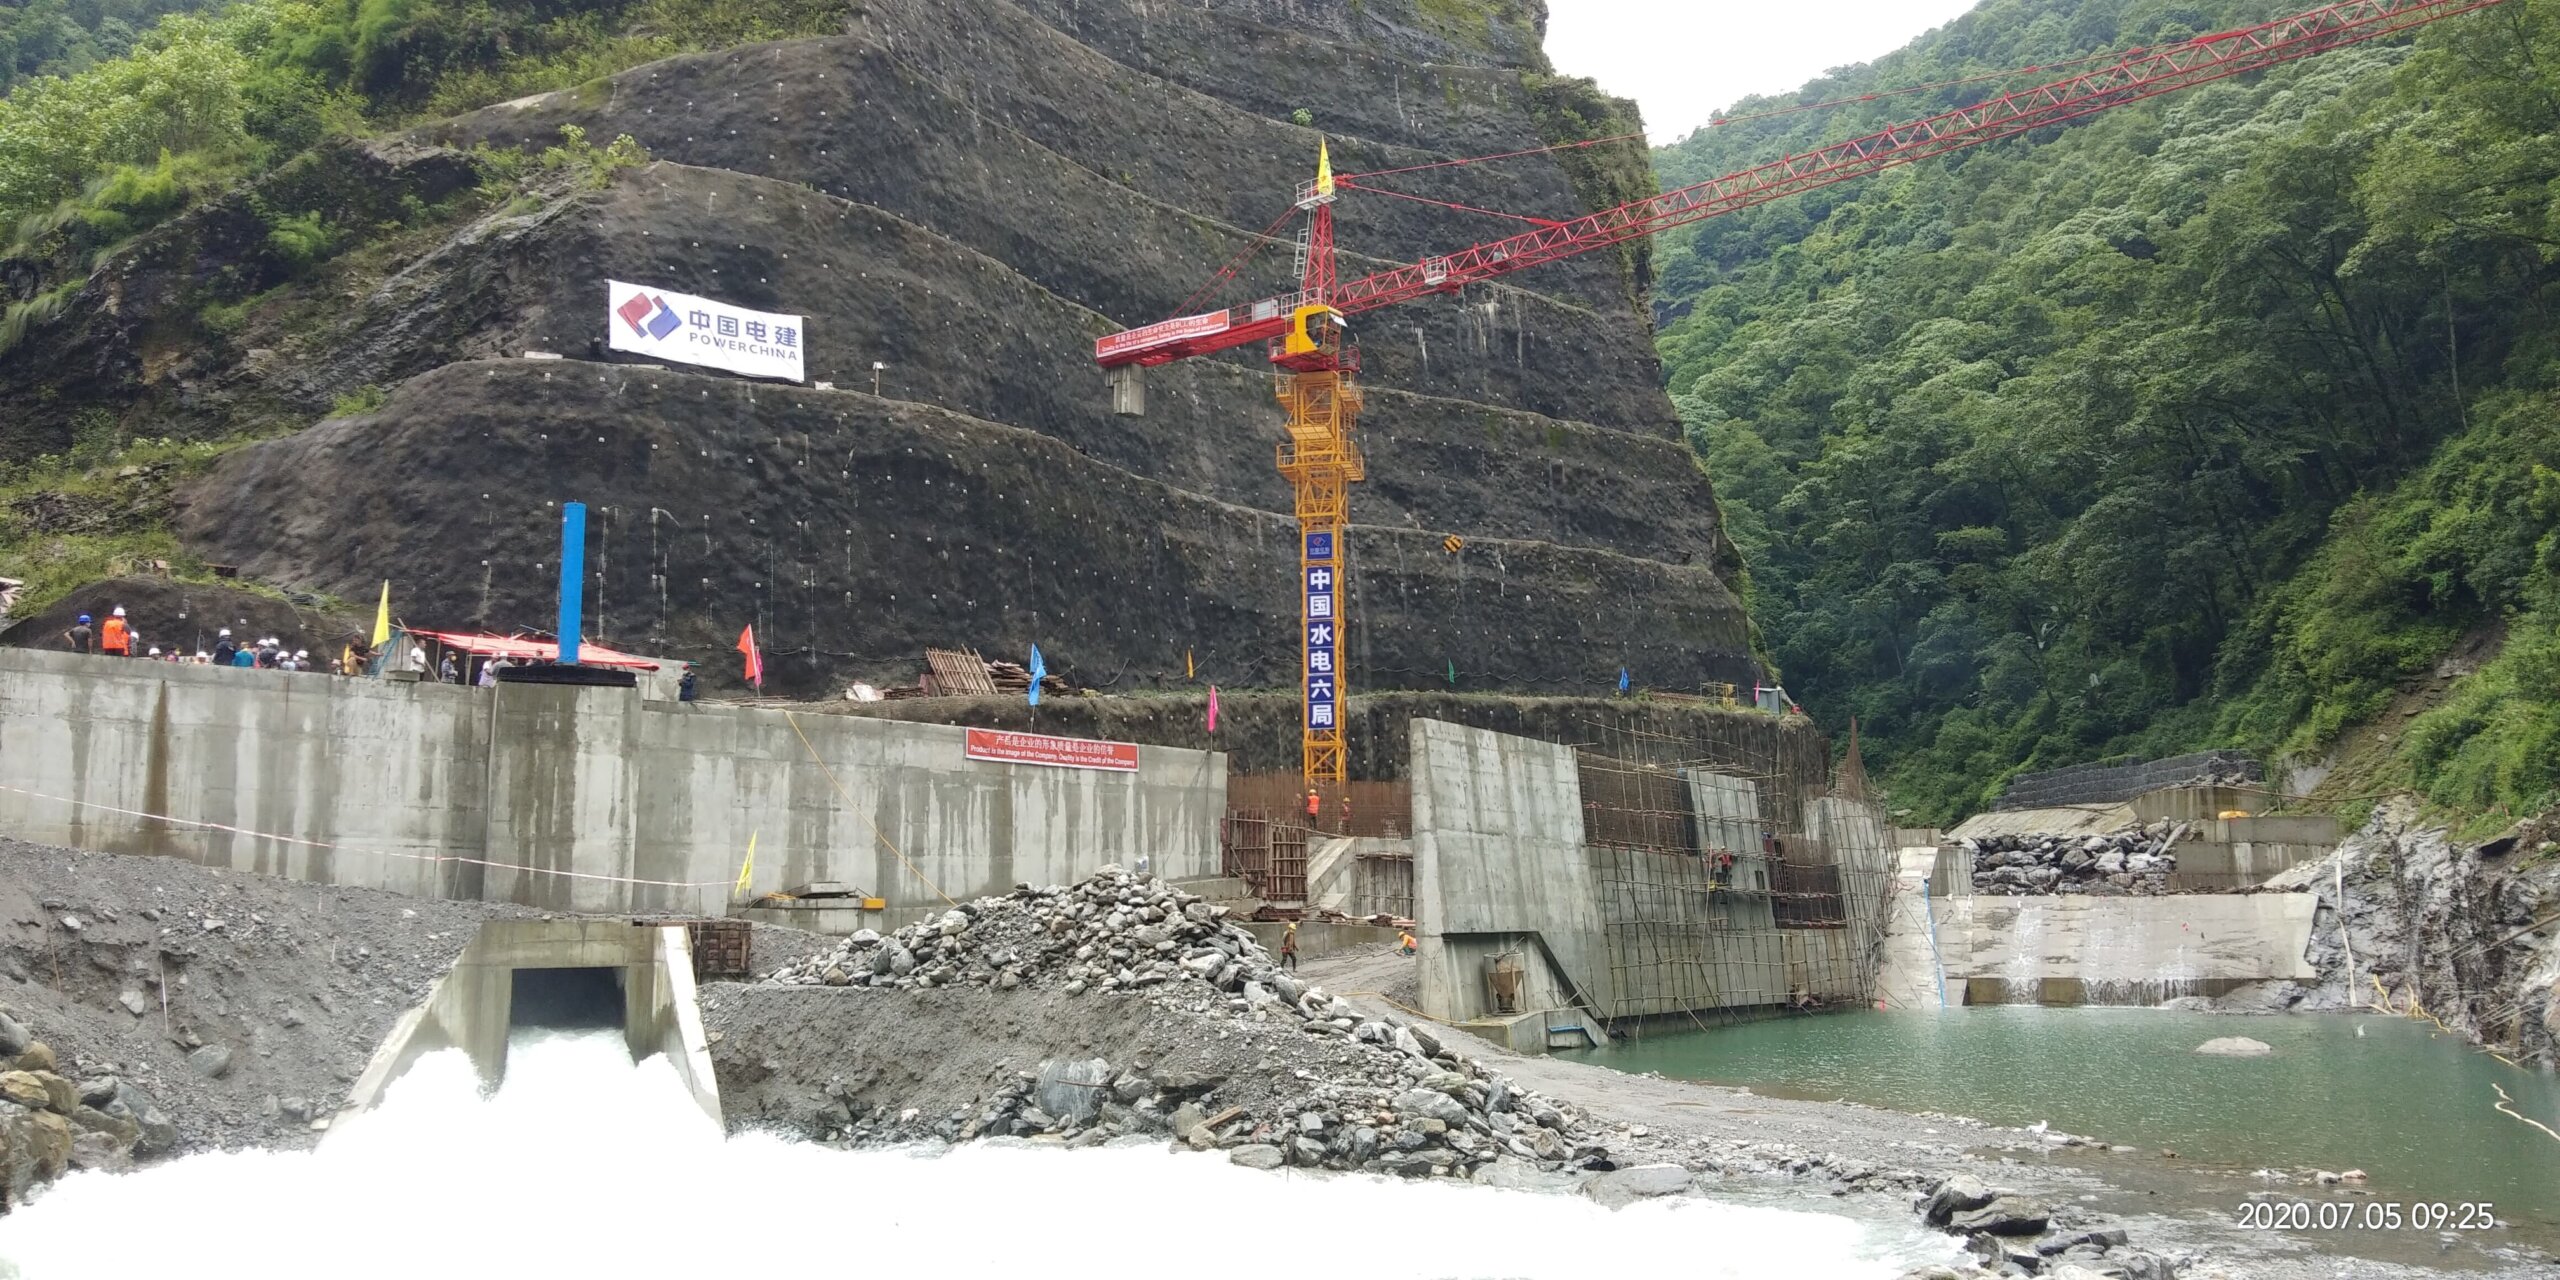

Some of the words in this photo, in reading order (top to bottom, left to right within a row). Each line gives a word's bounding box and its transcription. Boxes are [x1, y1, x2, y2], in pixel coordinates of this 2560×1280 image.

[689, 310, 797, 348] 中国电建
[689, 332, 798, 360] POWERCHINA
[1310, 569, 1333, 727] 中国水电六局
[970, 744, 991, 754] Product
[1026, 750, 1034, 758] the
[1080, 755, 1088, 763] the
